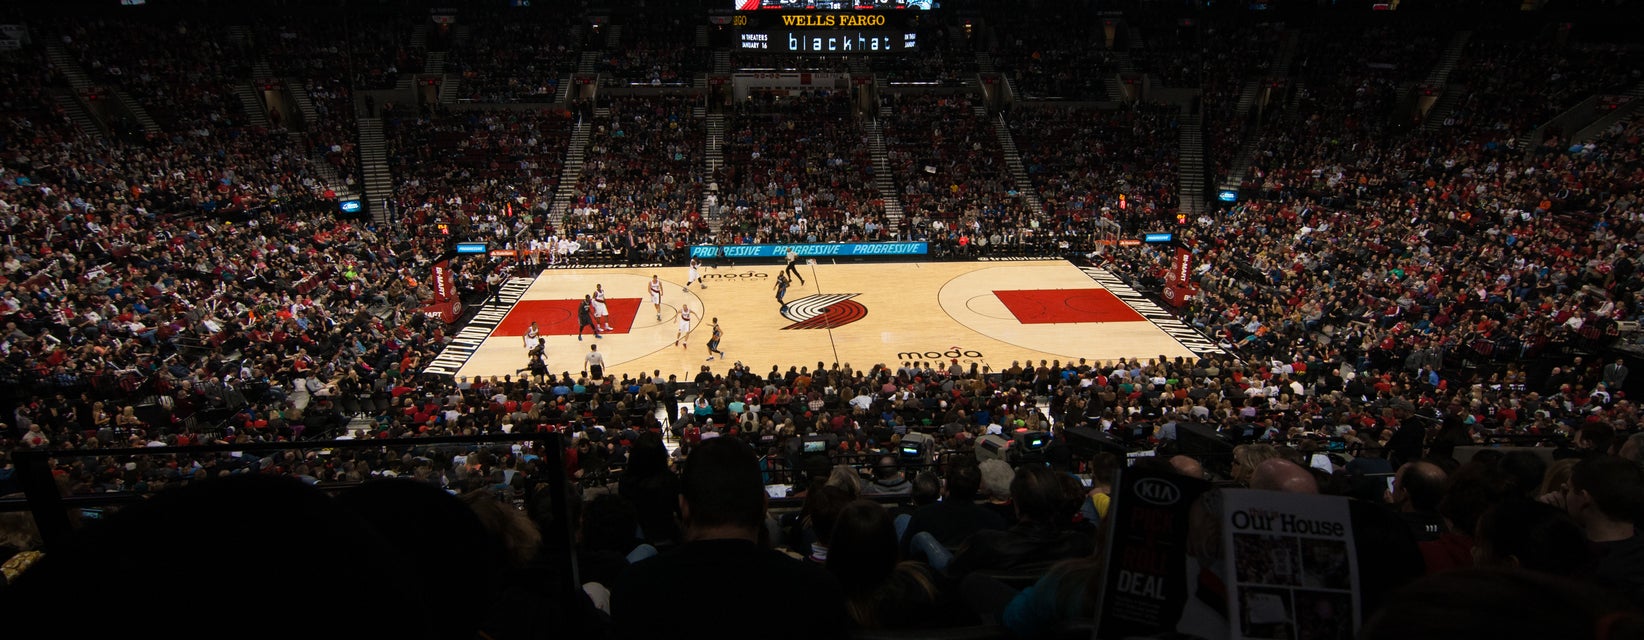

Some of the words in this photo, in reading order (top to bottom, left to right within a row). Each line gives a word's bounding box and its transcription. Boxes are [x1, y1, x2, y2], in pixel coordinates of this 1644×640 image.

[782, 15, 834, 26] WELLS
[839, 15, 885, 26] FARGO
[788, 33, 890, 50] blackhat
[852, 243, 920, 254] PROGRESSIVE
[422, 325, 492, 374] PORTLAND
[1141, 481, 1173, 500] KIA
[1232, 510, 1274, 531] Our
[1281, 513, 1344, 537] House
[1117, 568, 1167, 600] DEAL
